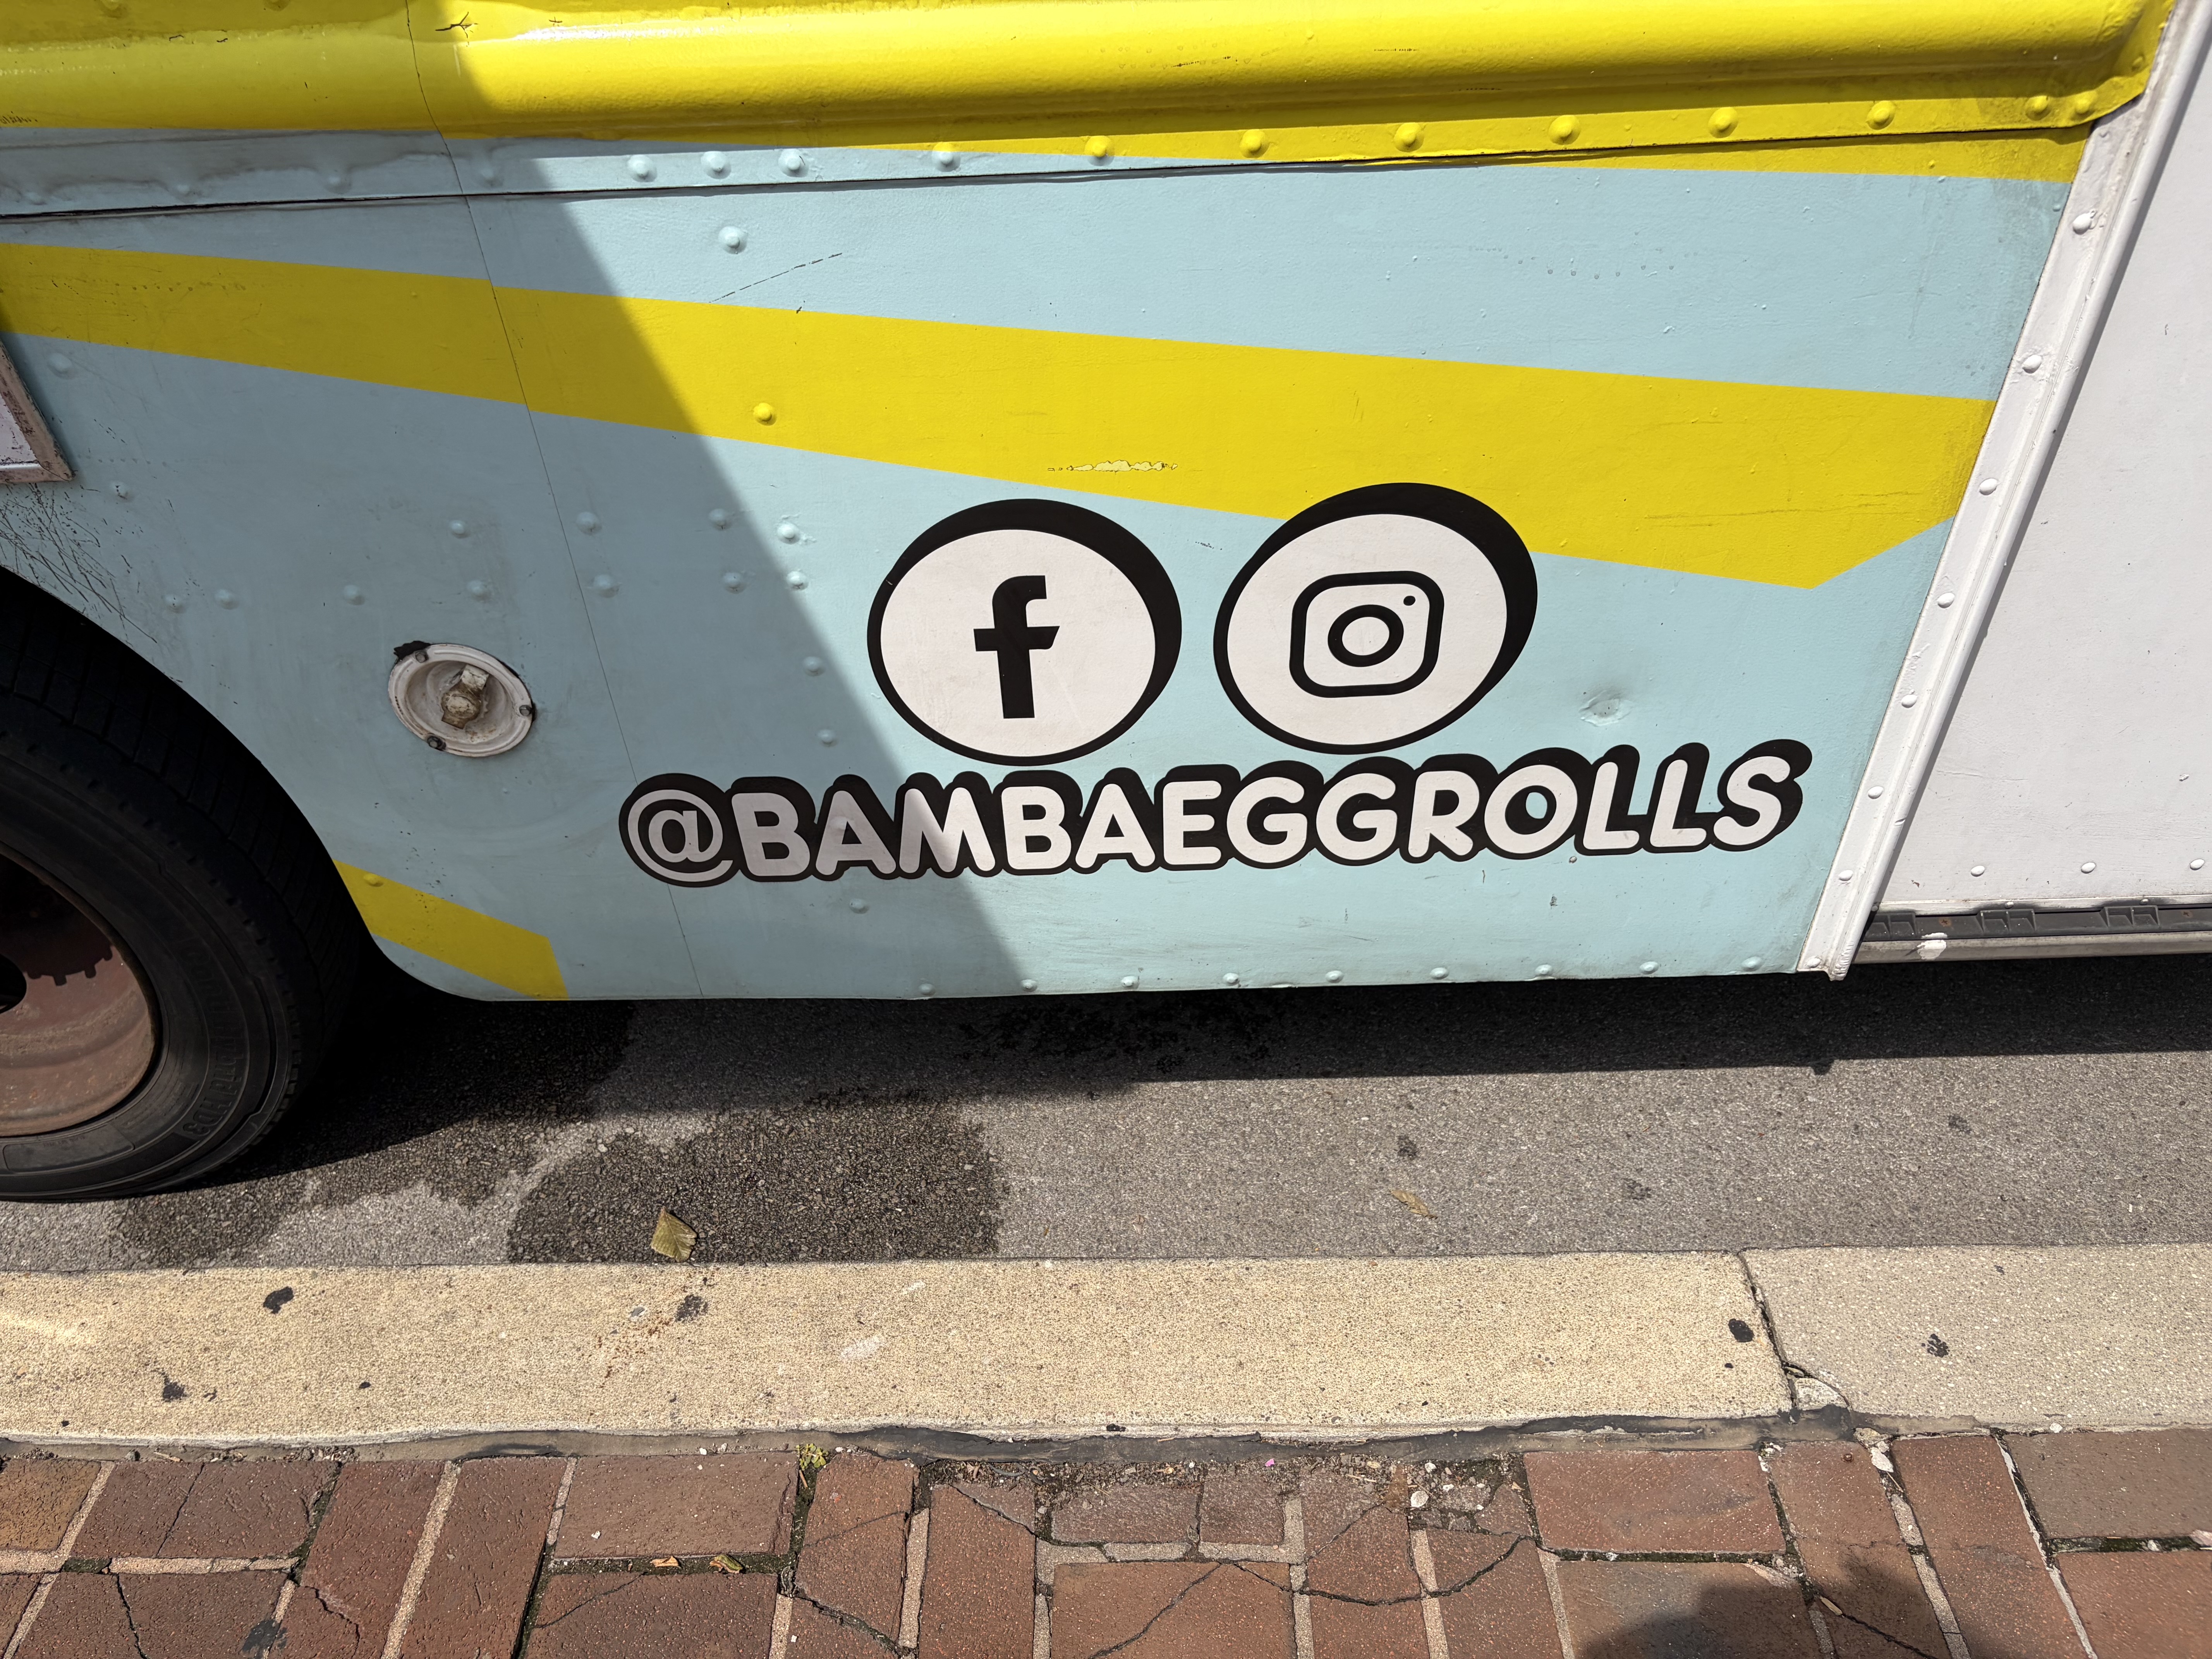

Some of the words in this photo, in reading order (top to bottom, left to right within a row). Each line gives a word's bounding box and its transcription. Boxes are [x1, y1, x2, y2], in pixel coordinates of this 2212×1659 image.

[973, 575, 1060, 718] f
[621, 742, 1809, 886] @BAMBAEGGROLLS
[183, 1096, 233, 1136] HD3
